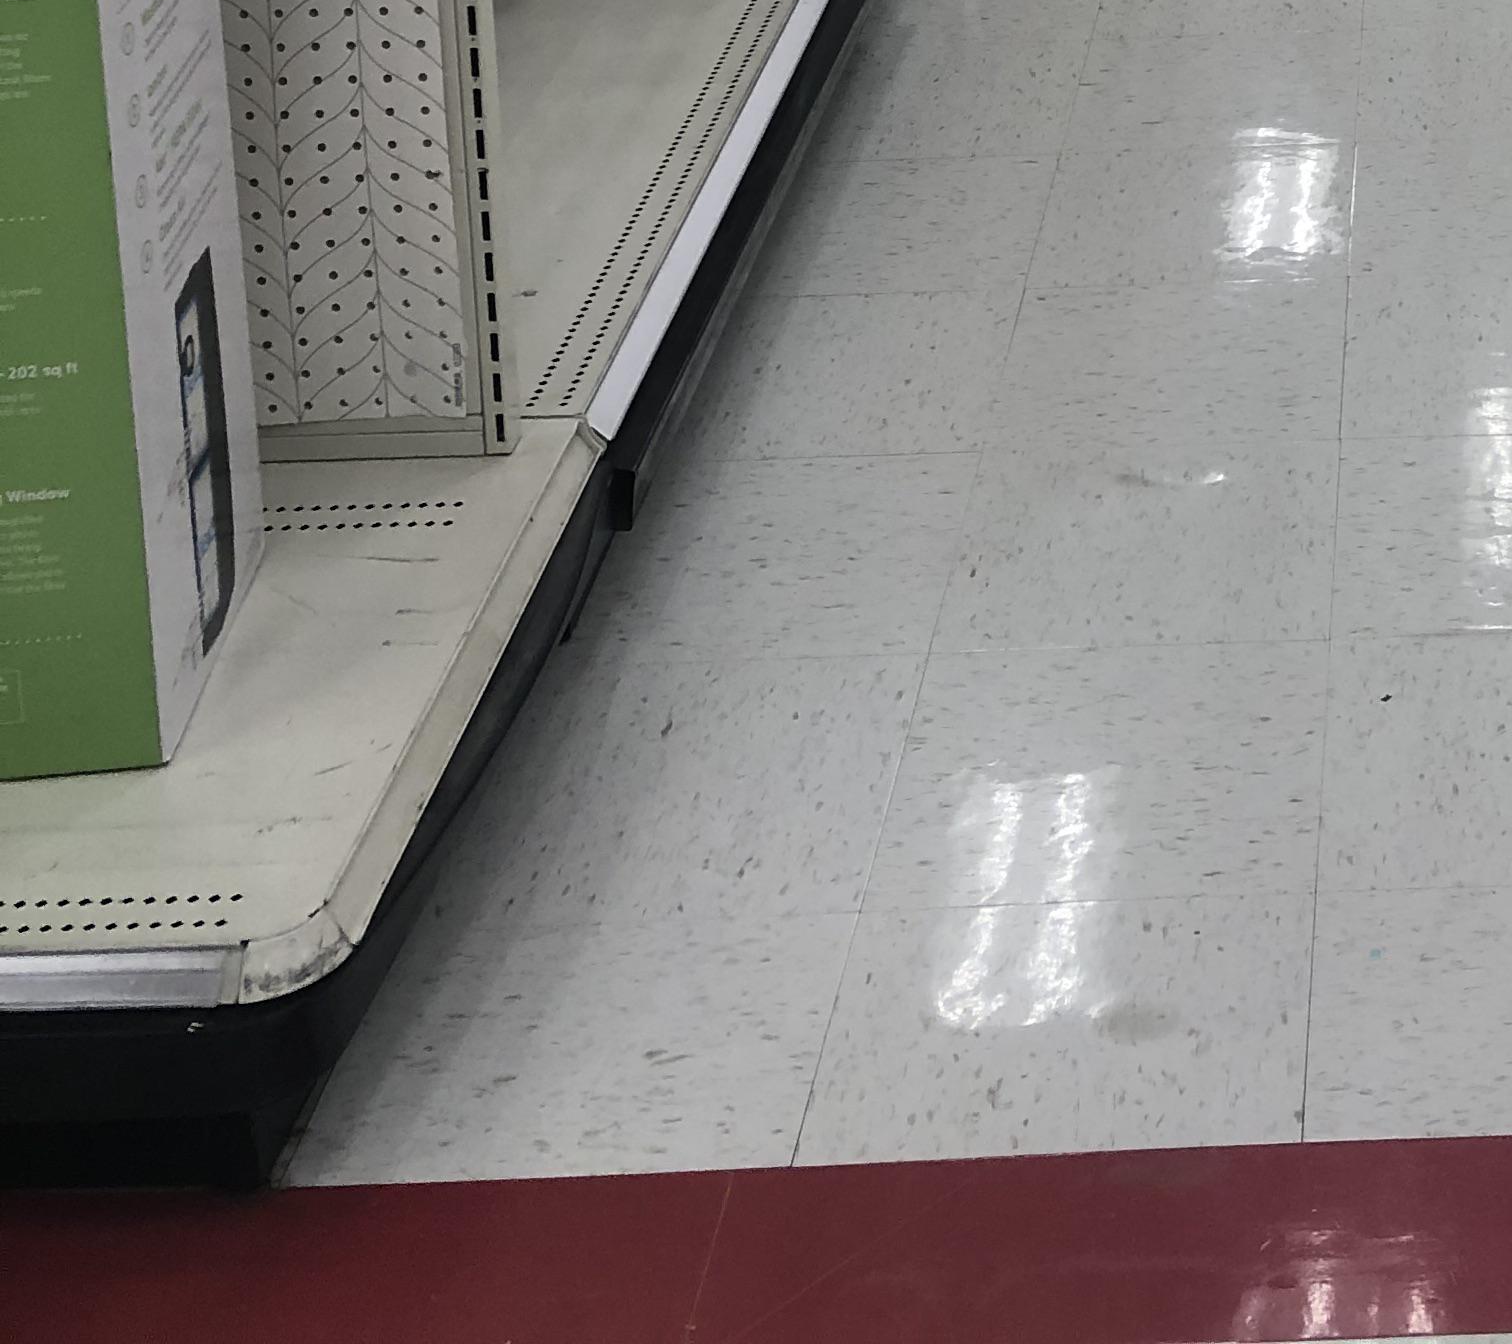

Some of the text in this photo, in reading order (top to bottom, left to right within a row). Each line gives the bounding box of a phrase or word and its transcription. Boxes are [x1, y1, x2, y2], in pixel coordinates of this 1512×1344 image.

[8, 361, 79, 380] 202 sq ft
[6, 488, 71, 503] Window
